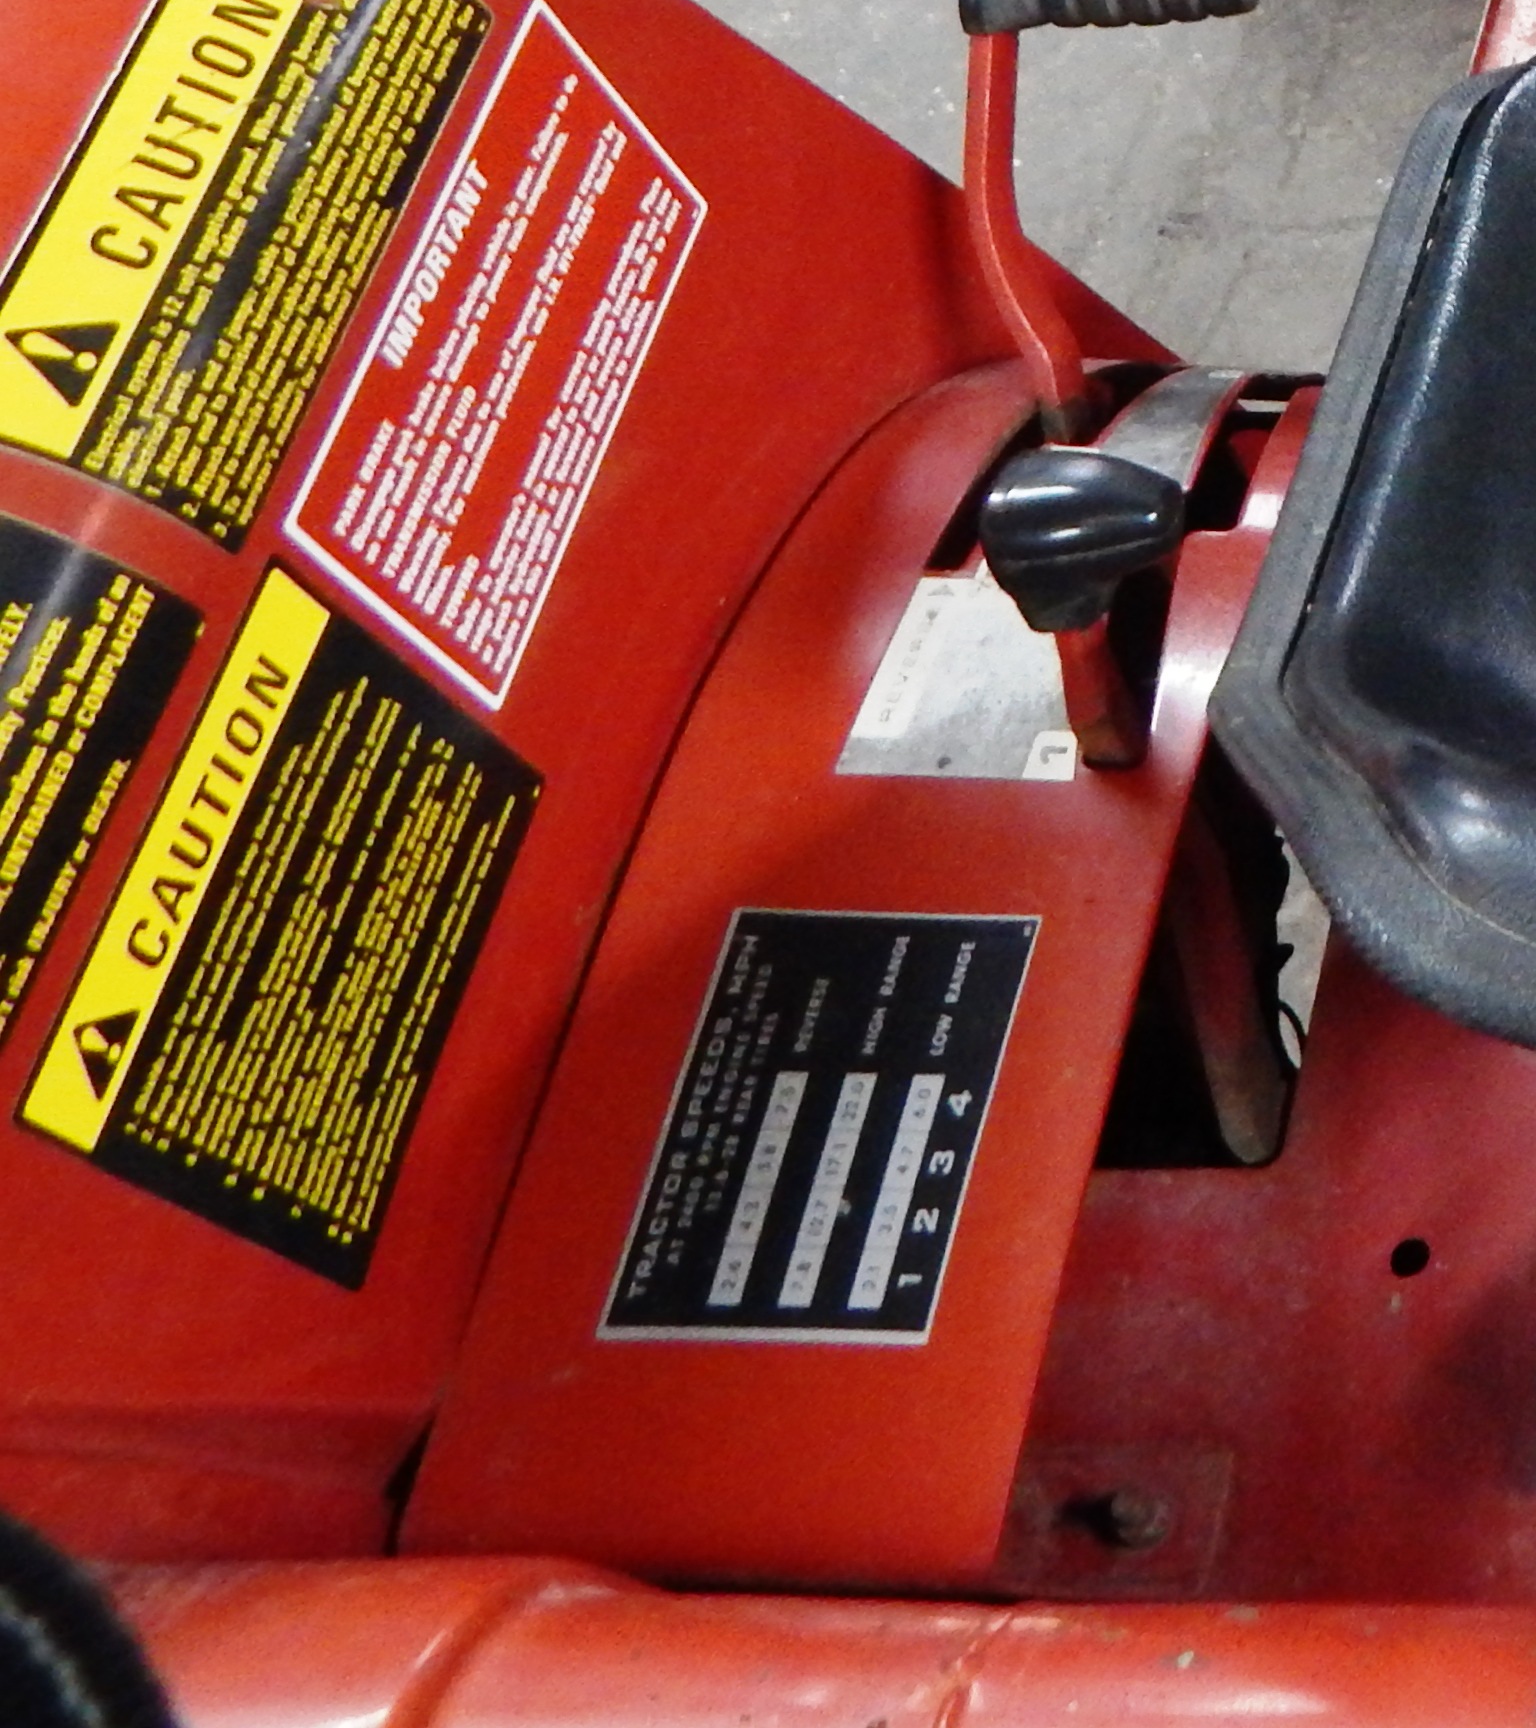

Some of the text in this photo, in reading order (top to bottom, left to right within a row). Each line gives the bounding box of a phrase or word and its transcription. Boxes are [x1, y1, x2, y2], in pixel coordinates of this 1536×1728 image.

[378, 155, 492, 374] IMPORTANT
[81, 392, 136, 472] Electrical
[380, 437, 452, 583] TRANSMISSION
[443, 381, 477, 443] FLUID
[330, 478, 367, 540] PARK
[3, 606, 71, 712] Practices.
[44, 678, 78, 721] the
[62, 618, 108, 684] hands
[92, 596, 119, 625] of
[72, 581, 157, 732] COMPLACENT
[64, 727, 88, 755] or
[0, 747, 77, 884] UNTRAINED
[120, 649, 291, 975] CAUTION
[859, 1005, 888, 1055] HIGH
[878, 934, 912, 995] RANGE
[927, 1012, 955, 1055] LOW
[942, 939, 977, 1004] RANGE
[625, 933, 761, 1298] TRACTOR SPEEDS, MPH
[894, 1088, 976, 1290] 1 2 3 4
